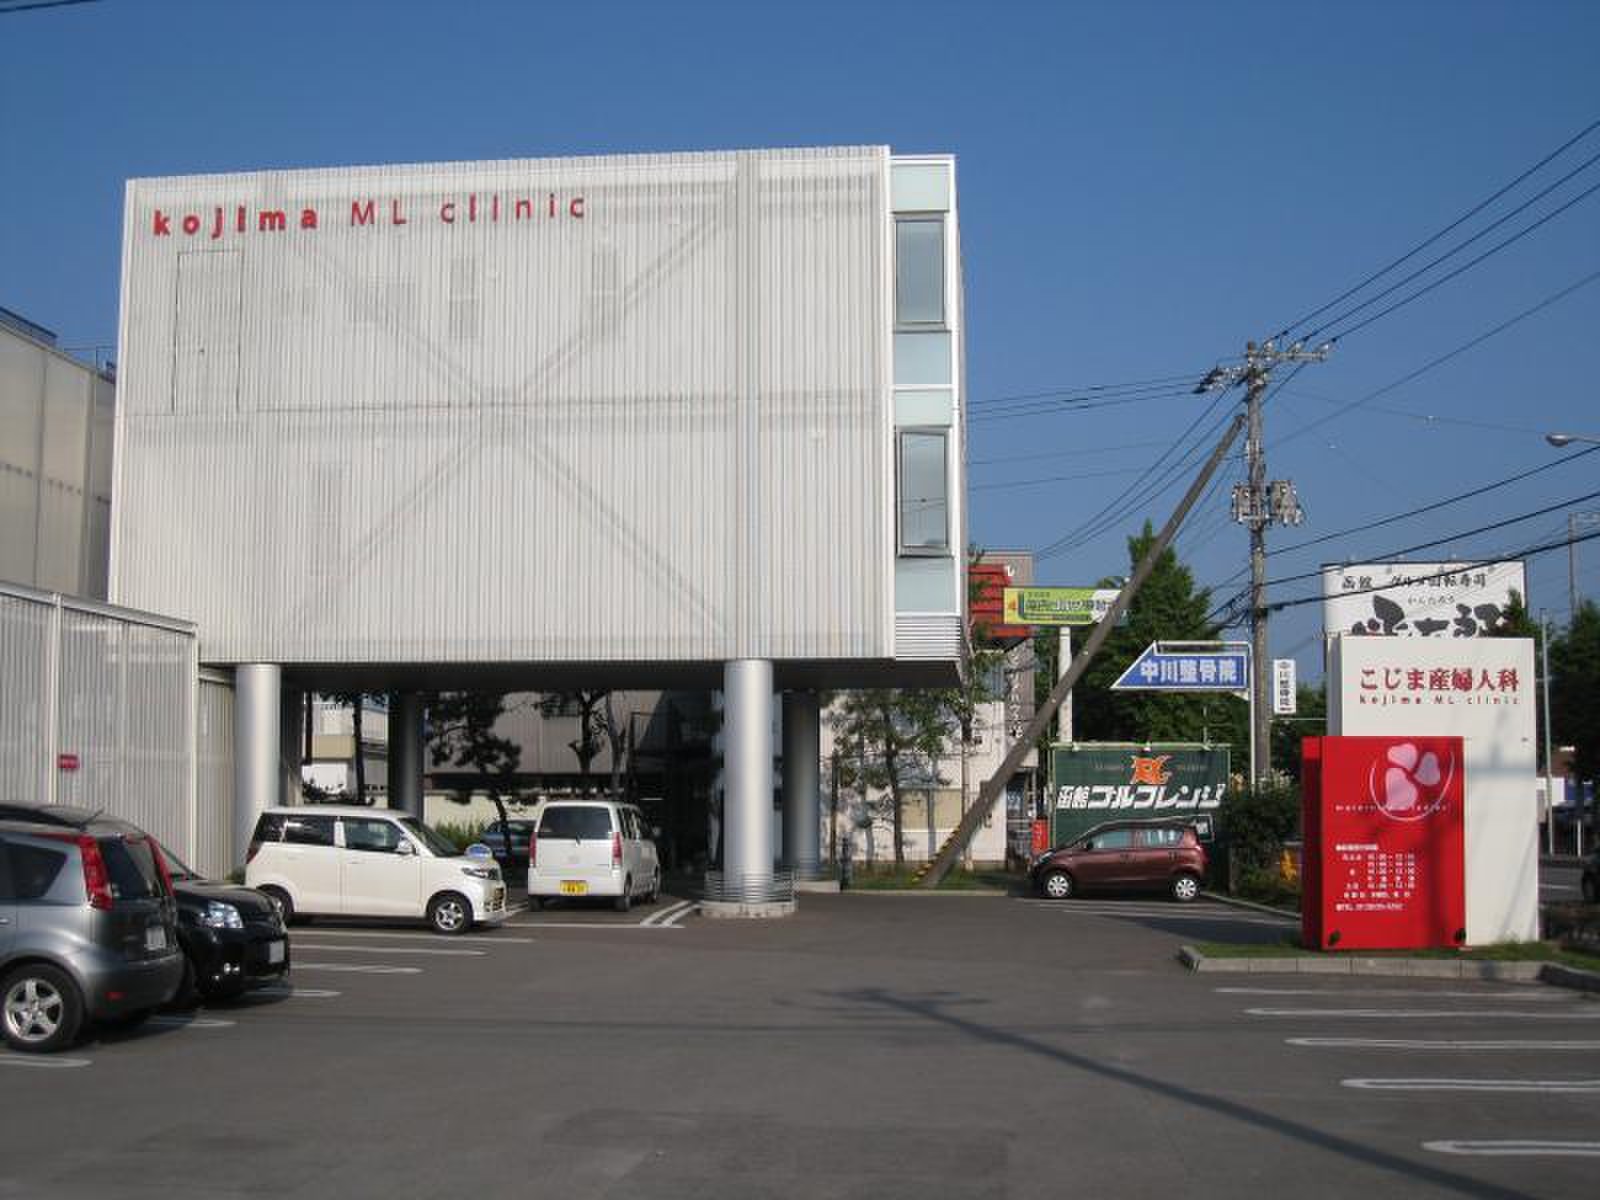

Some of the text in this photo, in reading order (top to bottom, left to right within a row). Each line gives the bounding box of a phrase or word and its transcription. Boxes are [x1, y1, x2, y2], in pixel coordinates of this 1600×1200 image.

[152, 193, 586, 239] kojima ML clinic
[1140, 658, 1237, 684] 中川整骨院
[1359, 667, 1520, 693] こじま産婦人科
[1432, 695, 1455, 705] ML
